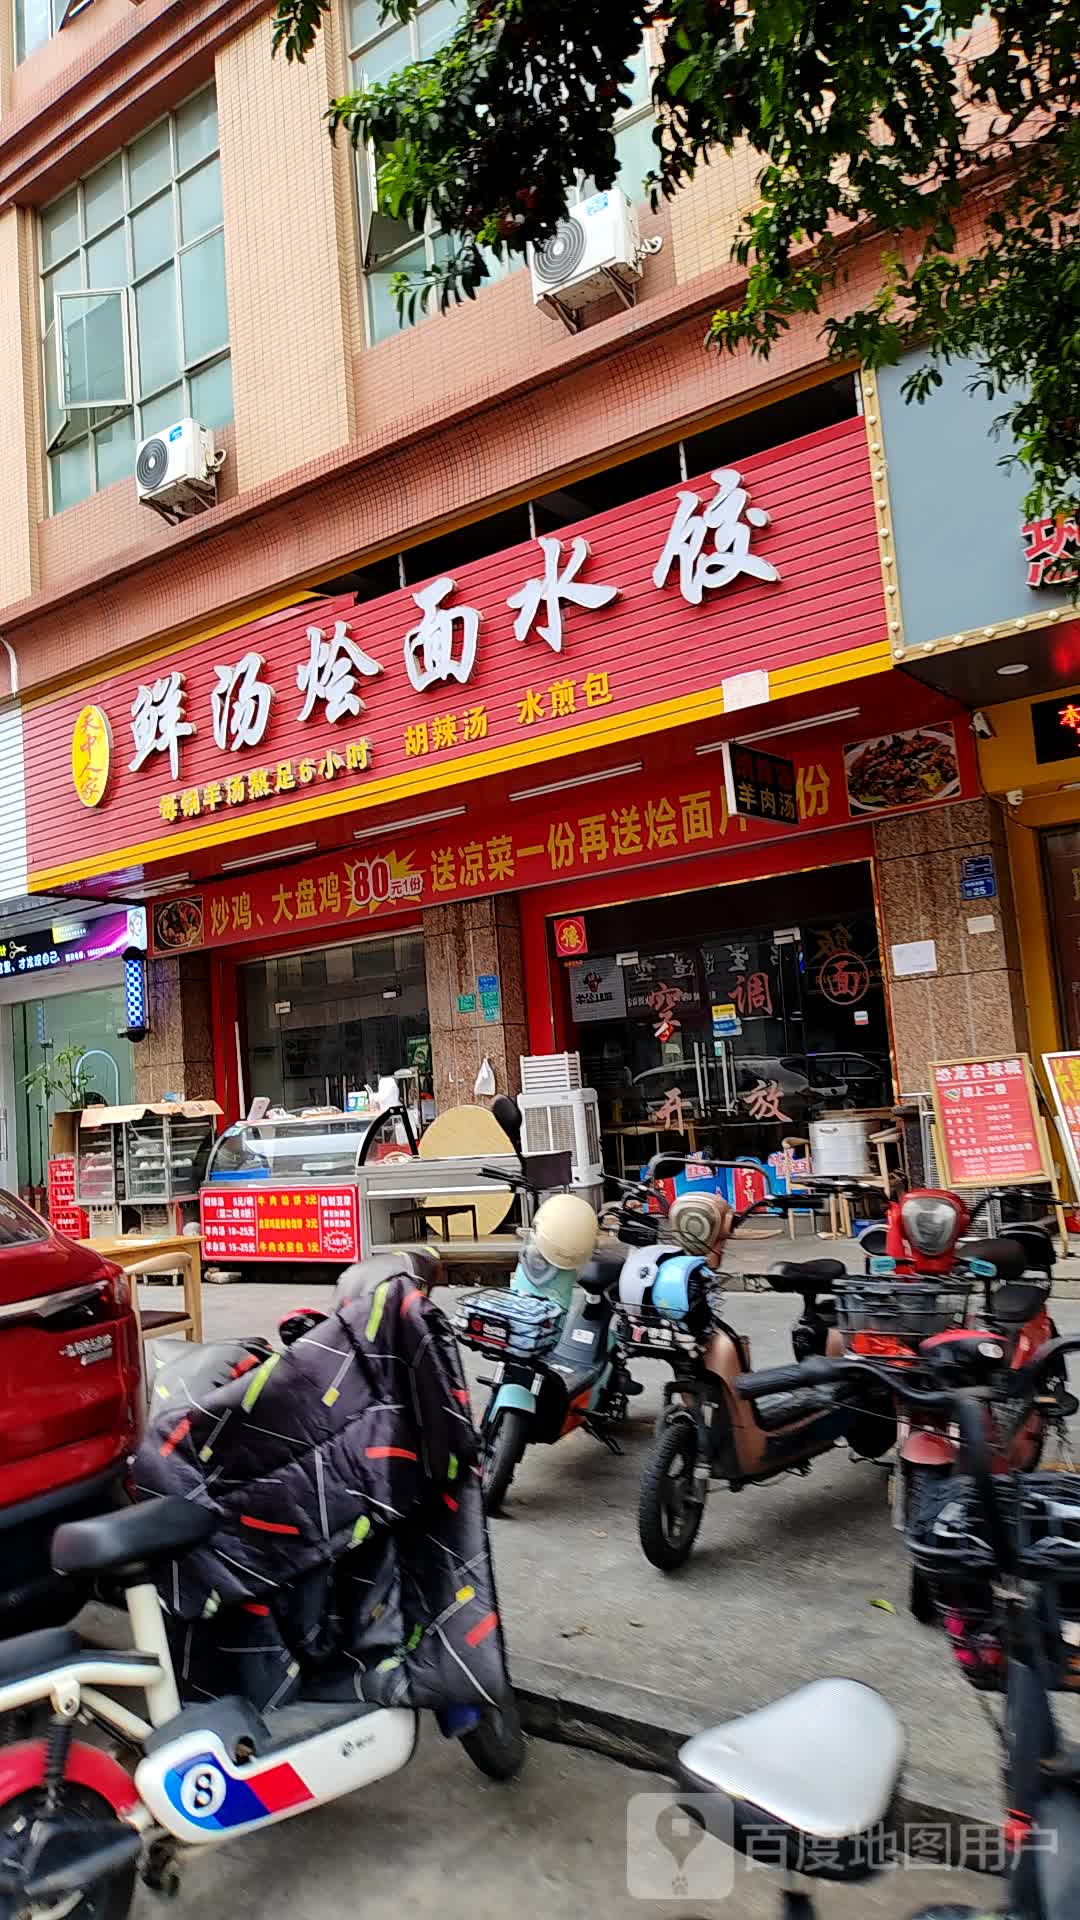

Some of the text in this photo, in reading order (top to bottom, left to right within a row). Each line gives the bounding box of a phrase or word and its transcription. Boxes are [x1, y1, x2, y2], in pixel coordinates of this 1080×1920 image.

[128, 468, 781, 780] 鲜汤烩面水饺
[404, 672, 613, 756] 胡辣汤 水煎包
[737, 781, 796, 819] 羊肉汤
[210, 871, 342, 937] 炒鸡、大盘鸡
[352, 860, 424, 905] 80元1份
[431, 764, 831, 893] 送凉菜一份再送烩面份
[194, 1772, 213, 1809] 8
